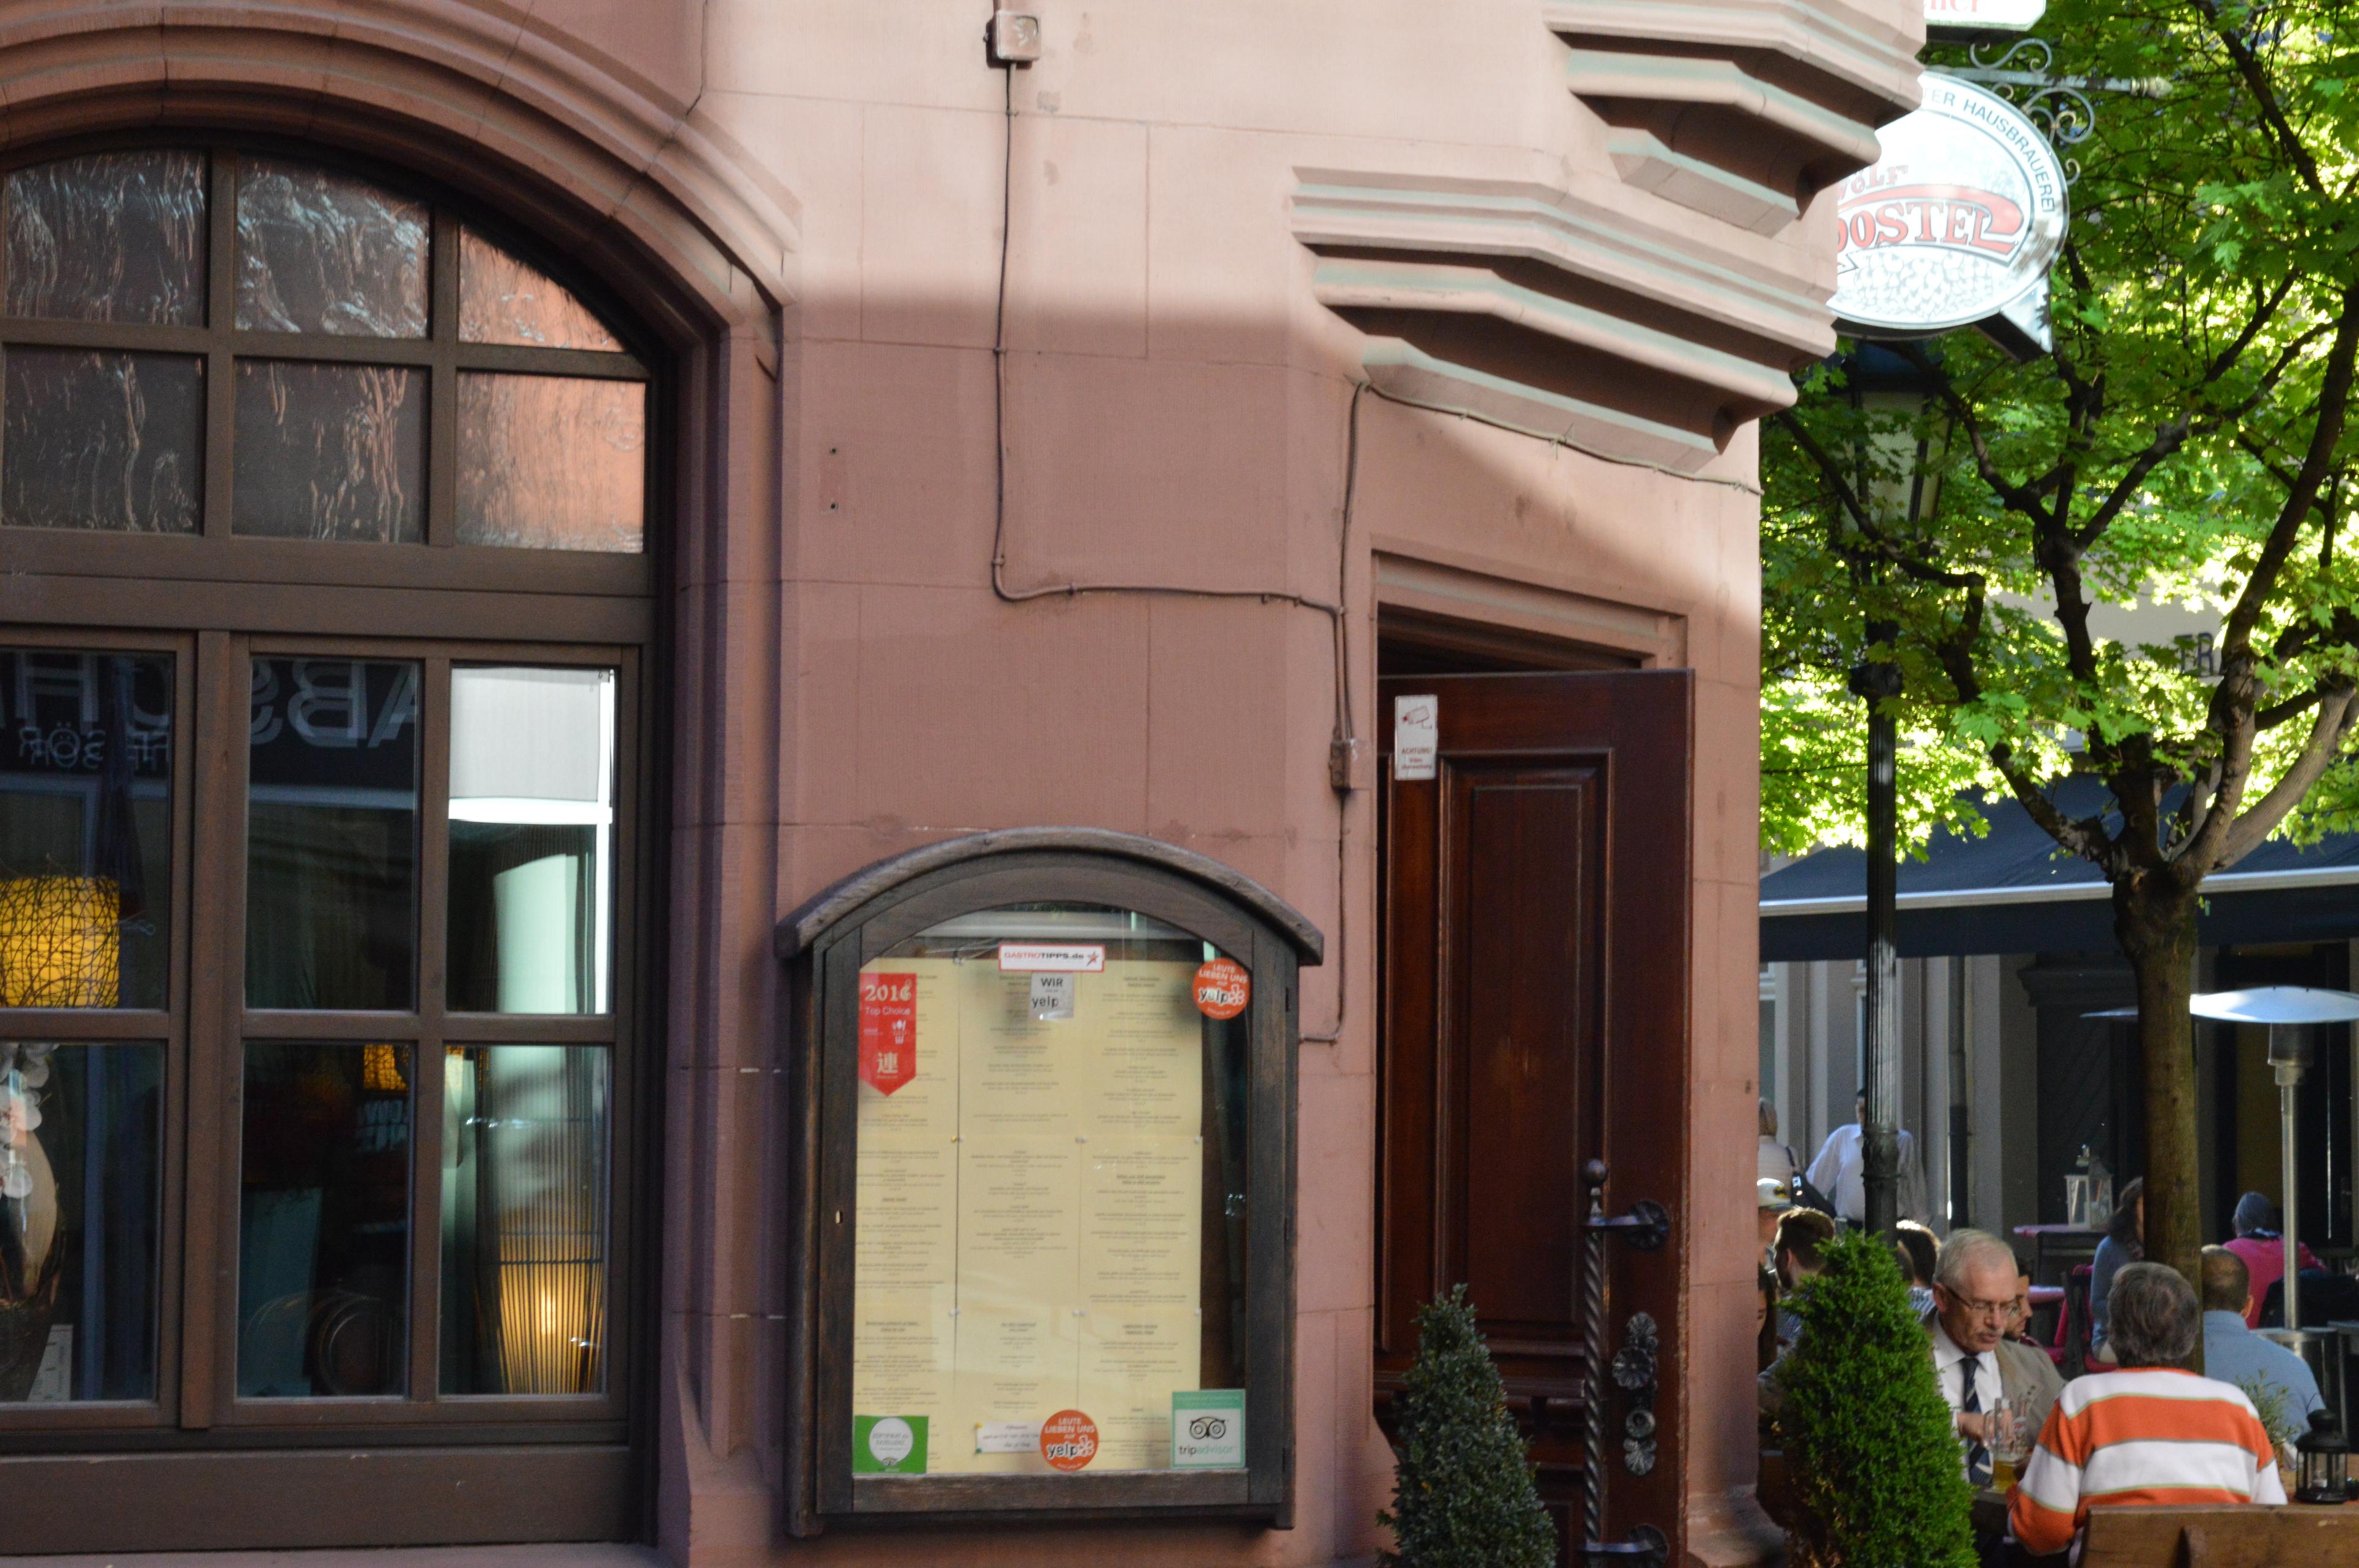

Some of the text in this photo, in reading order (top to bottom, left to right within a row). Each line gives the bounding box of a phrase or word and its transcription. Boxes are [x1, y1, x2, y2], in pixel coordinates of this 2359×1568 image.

[1962, 99, 2056, 213] HAUSBRAUEREI
[1041, 977, 1063, 988] WIR
[1199, 969, 1248, 984] LIEBEN UNS
[864, 983, 912, 1002] 2016
[1199, 987, 1229, 1005] yelp
[1031, 996, 1060, 1009] yelp
[1058, 1417, 1082, 1426] LEUTE
[1044, 1425, 1075, 1434] LIEBEN
[1047, 1443, 1078, 1459] yelp
